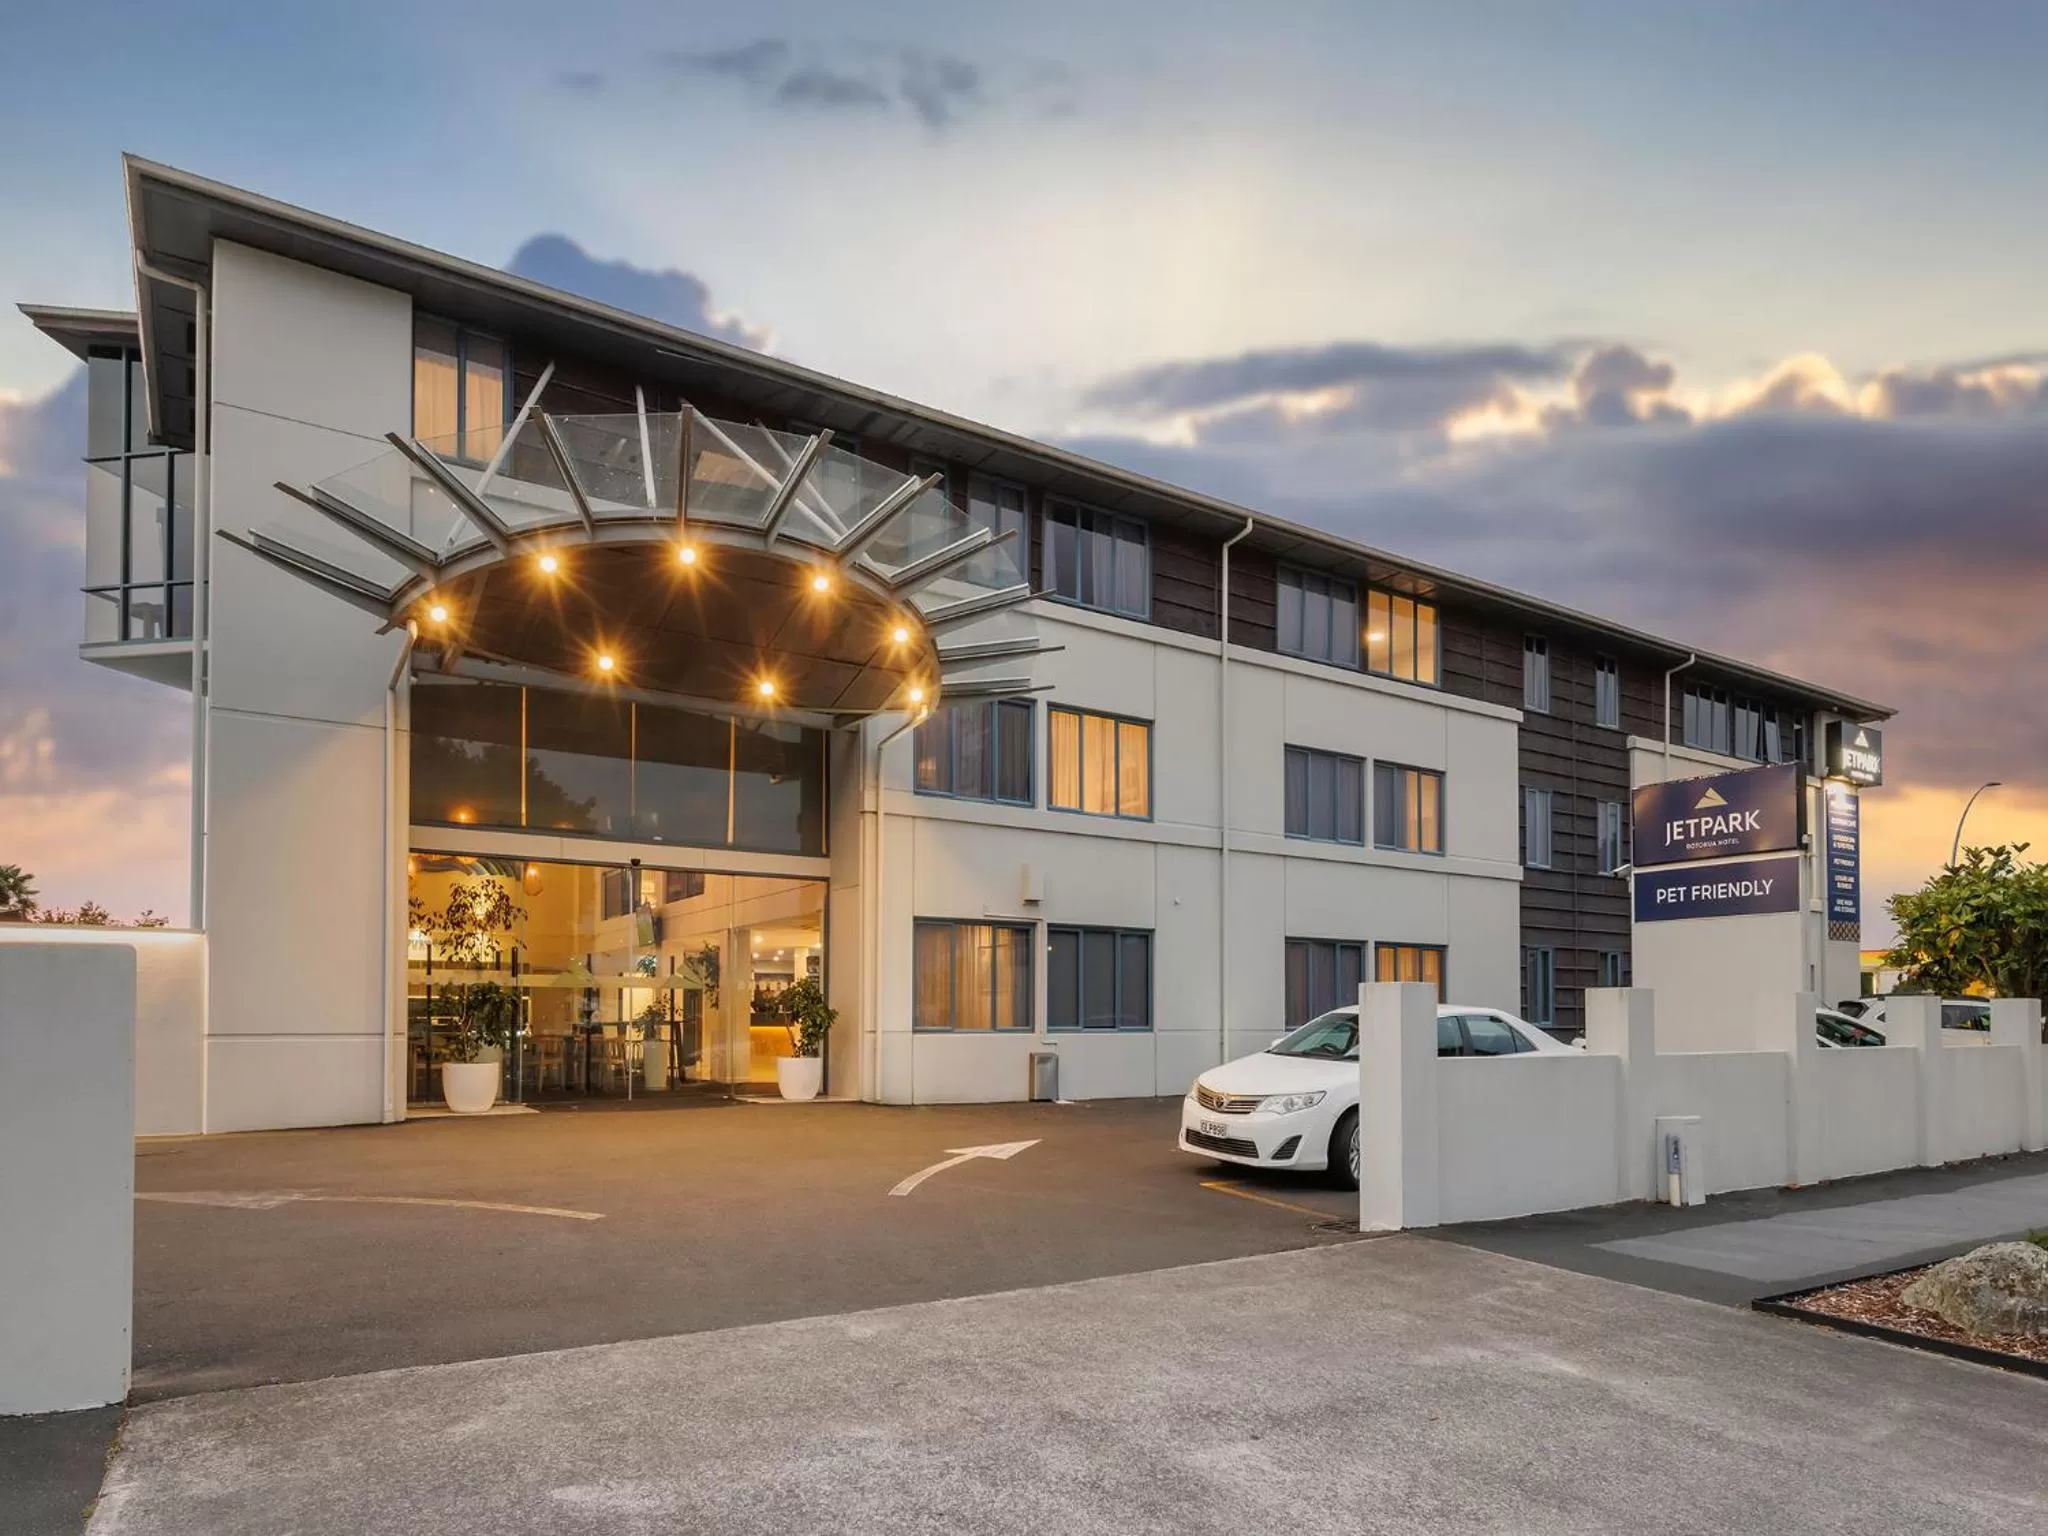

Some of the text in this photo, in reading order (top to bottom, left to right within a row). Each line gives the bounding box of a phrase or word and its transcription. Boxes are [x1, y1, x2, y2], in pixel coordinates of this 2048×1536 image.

[1664, 809, 1761, 846] JETPARK
[1656, 879, 1773, 904] PET FRIENDLY
